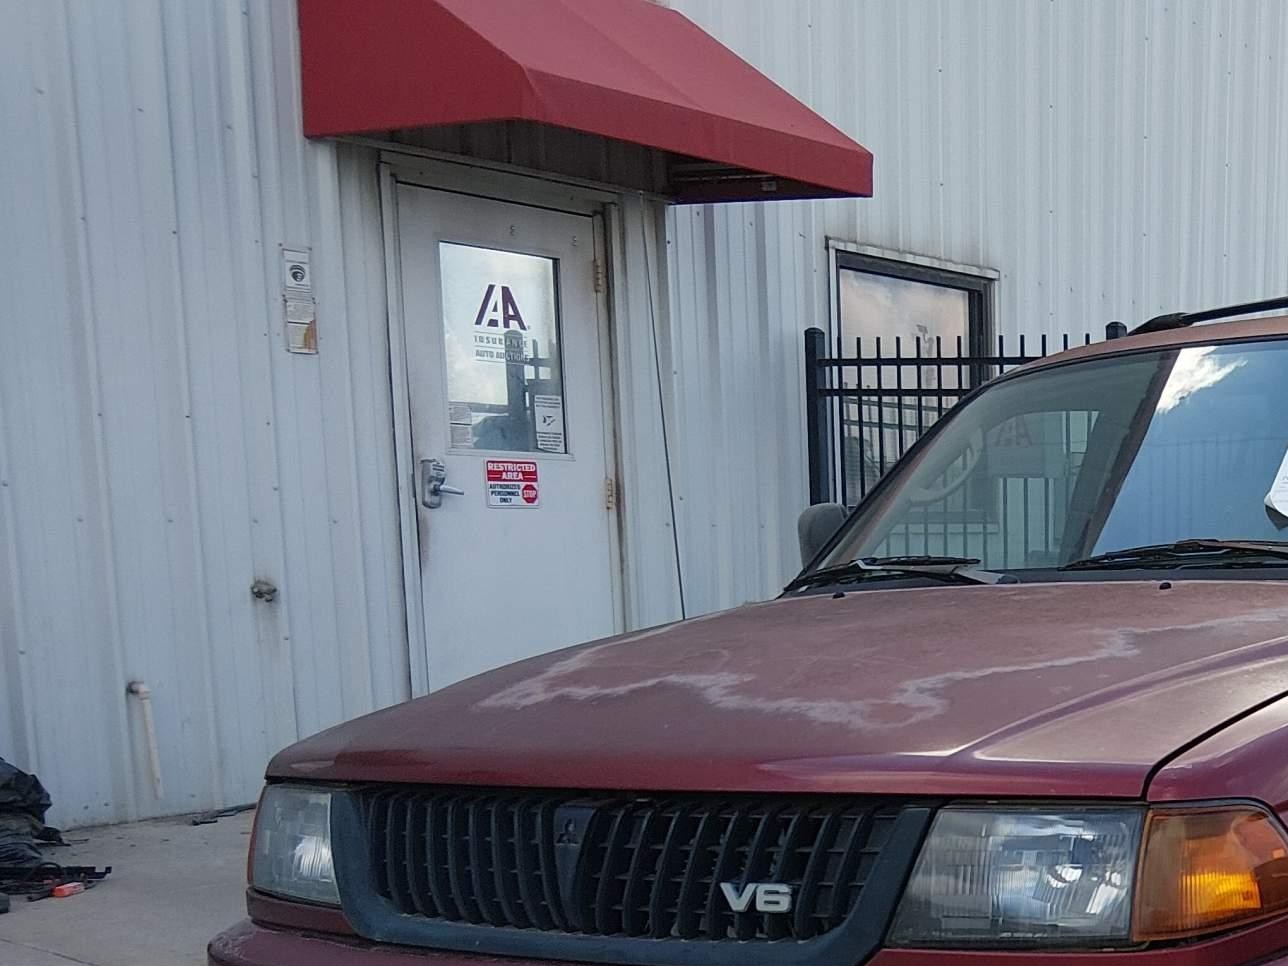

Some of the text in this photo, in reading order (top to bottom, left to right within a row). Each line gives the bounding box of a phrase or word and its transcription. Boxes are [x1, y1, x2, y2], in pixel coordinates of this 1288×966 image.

[487, 462, 536, 471] RESTRICTED
[501, 471, 524, 480] AREA
[720, 882, 792, 912] V6
